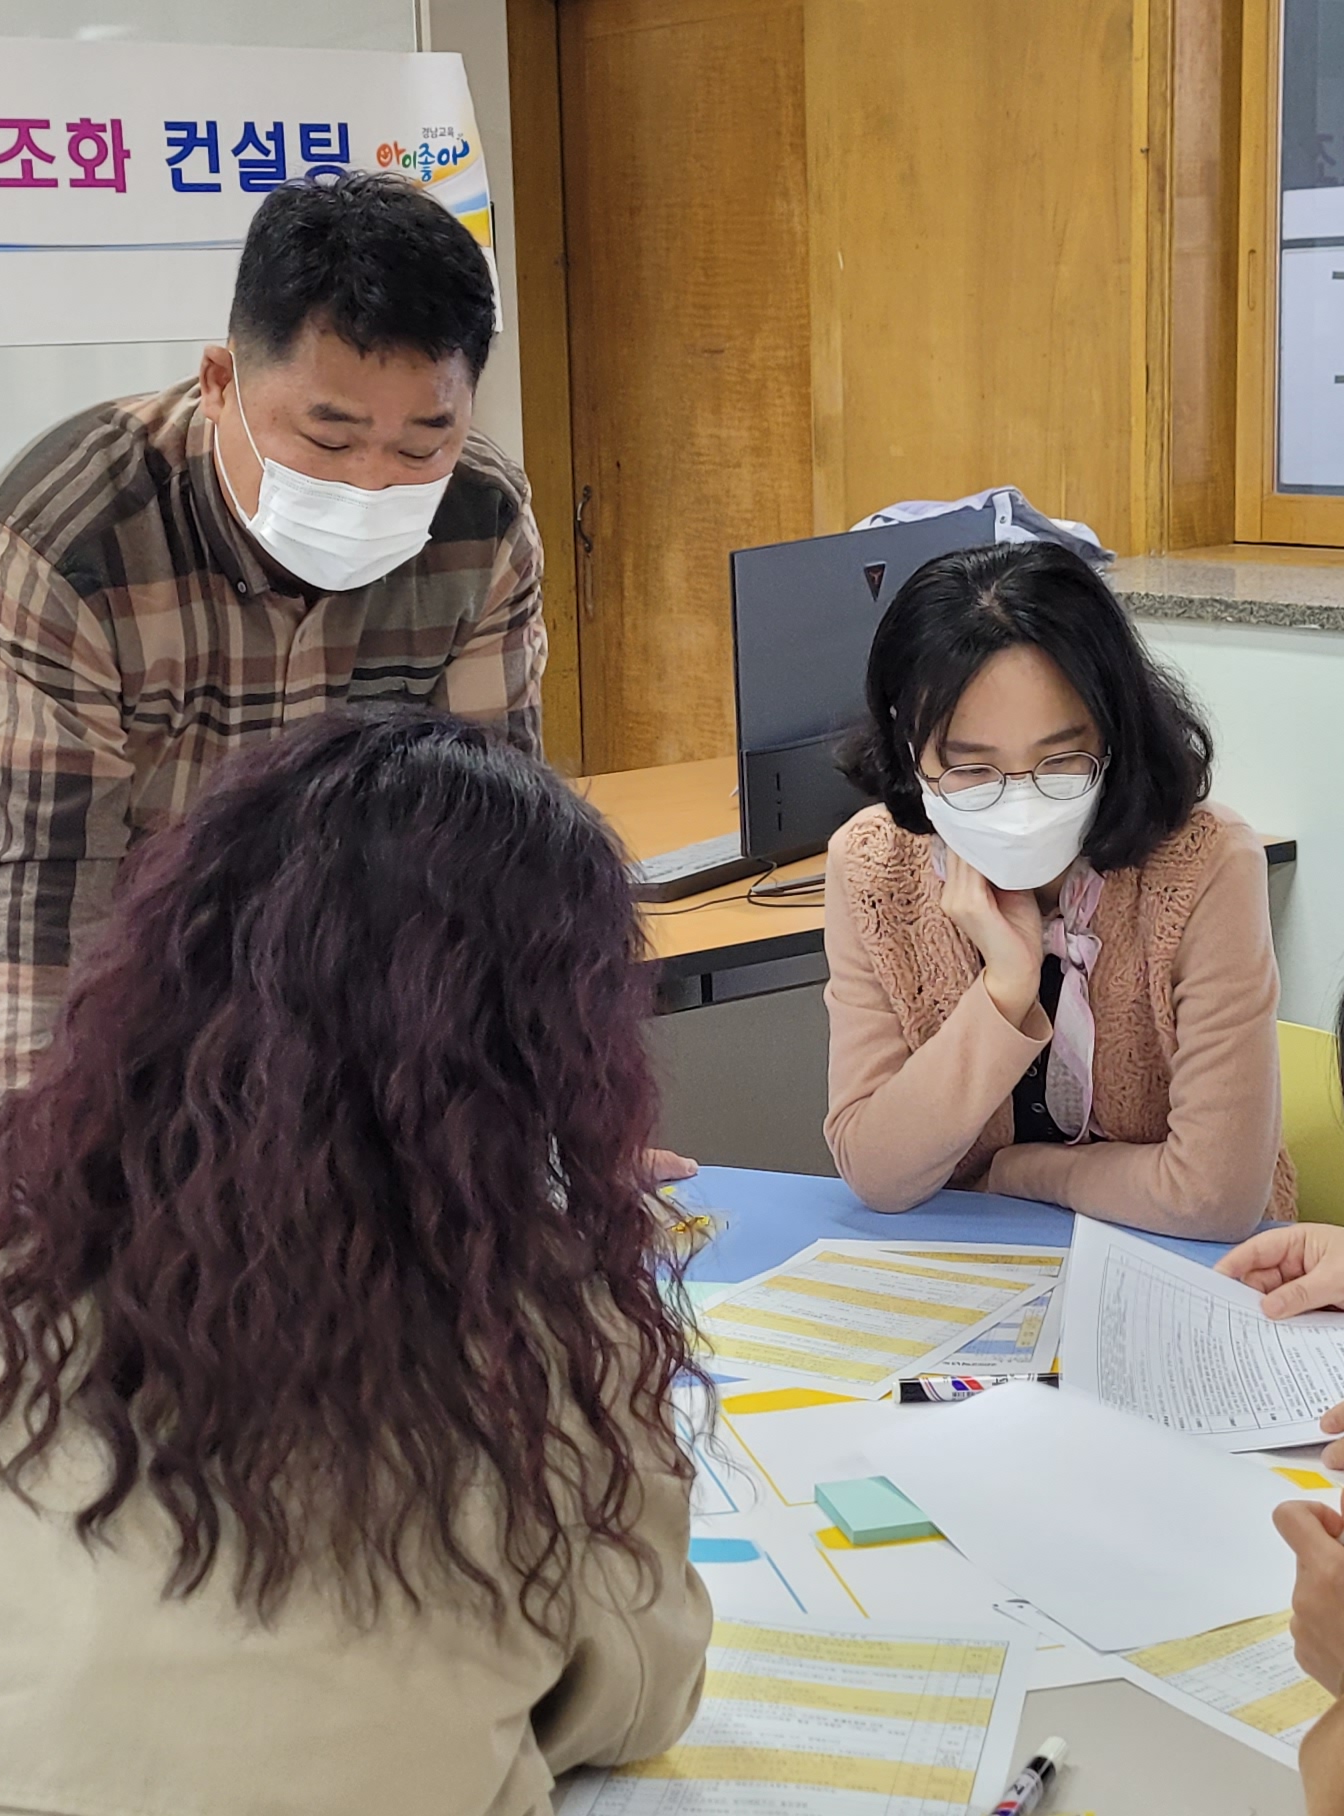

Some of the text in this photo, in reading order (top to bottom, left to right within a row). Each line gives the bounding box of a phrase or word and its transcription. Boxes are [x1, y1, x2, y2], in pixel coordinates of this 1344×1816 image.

[421, 127, 454, 139] 경남교육
[163, 120, 351, 193] 컨설팅
[376, 138, 470, 182] 아이좋아
